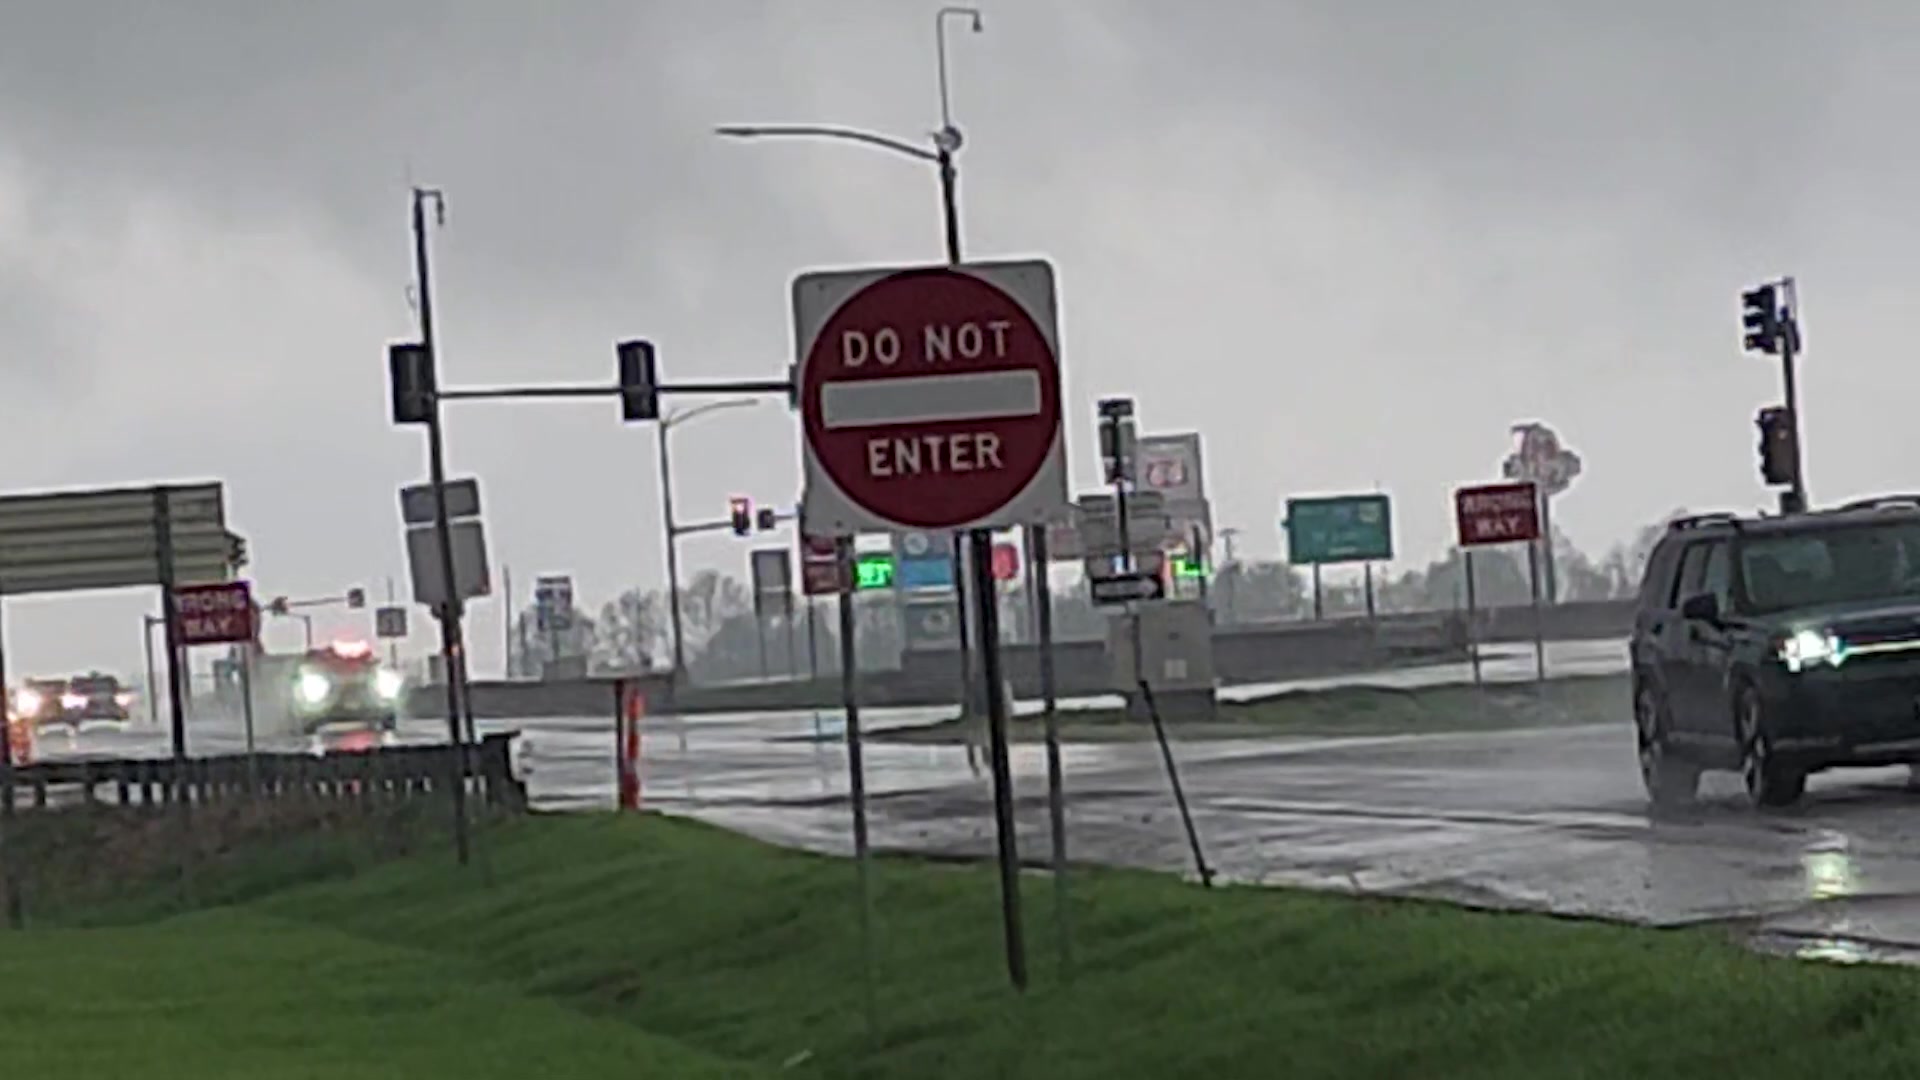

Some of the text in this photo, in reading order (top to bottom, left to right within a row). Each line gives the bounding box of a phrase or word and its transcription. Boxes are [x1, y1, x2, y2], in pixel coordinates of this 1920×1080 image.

[842, 321, 1011, 367] DO NOT
[868, 434, 1003, 477] ENTER
